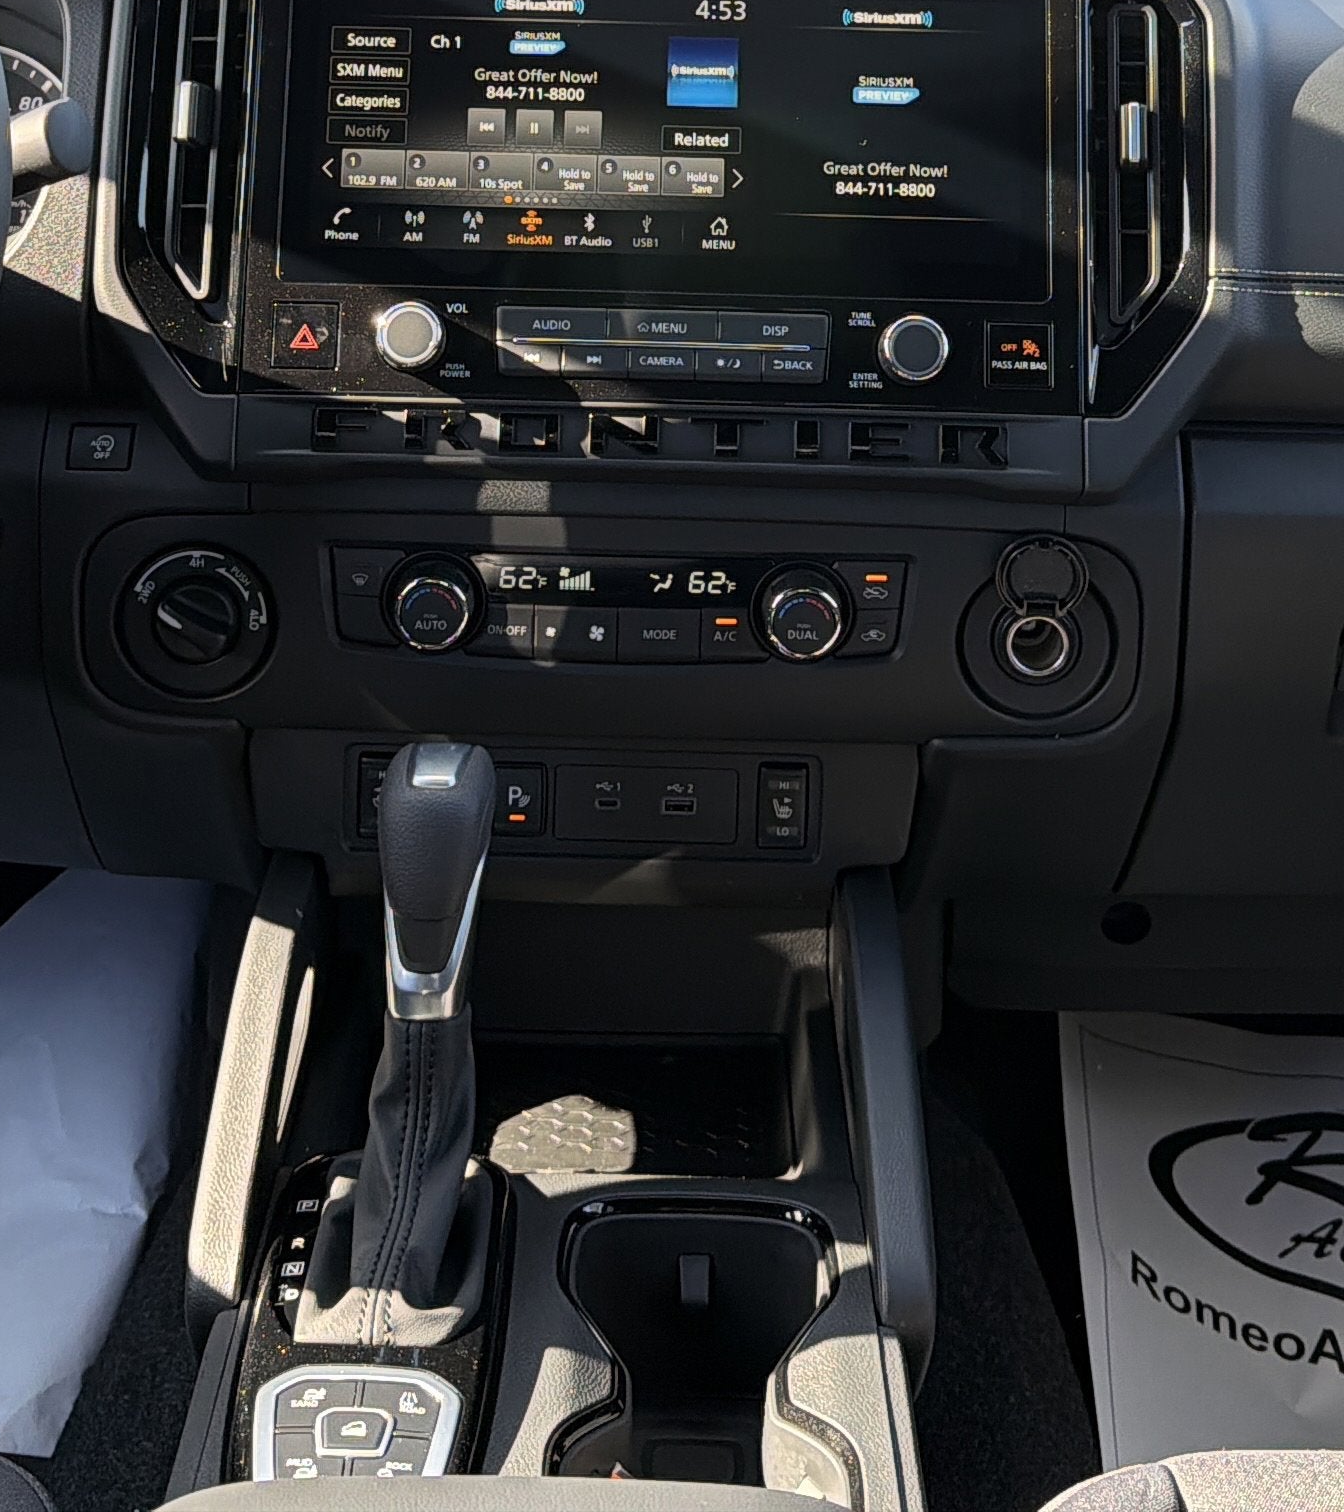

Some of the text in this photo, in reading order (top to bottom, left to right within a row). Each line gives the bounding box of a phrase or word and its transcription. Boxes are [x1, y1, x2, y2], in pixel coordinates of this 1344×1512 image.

[696, 0, 747, 21] 4:53
[347, 33, 396, 47] Source
[430, 34, 462, 49] Ch 1
[337, 64, 403, 78] SXM Menu
[474, 68, 598, 84] Great Offer Now!
[858, 75, 914, 87] SIRIUSXM
[486, 86, 585, 102] 844-711-8800
[336, 94, 401, 110] Categories
[344, 124, 391, 141] Notify
[674, 132, 729, 147] Related
[559, 169, 591, 180] Hold to
[823, 161, 948, 178] Great Offer Now!
[348, 175, 397, 186] 102.9 FM
[415, 176, 457, 188] 620 AM
[622, 170, 655, 182] Hold to
[686, 172, 719, 184] Hold to
[479, 178, 523, 192] 10s Spot
[564, 179, 586, 191] Save
[627, 181, 649, 193] Save
[691, 183, 713, 195] Save
[835, 181, 936, 197] 844-711-8800
[324, 229, 359, 241] Phone
[403, 231, 424, 242] AM
[463, 232, 480, 243] FM
[506, 234, 553, 246] SiriusXM
[565, 235, 613, 247] BT Audio
[632, 237, 659, 248] USB1
[702, 238, 736, 250] MENU
[446, 303, 468, 314] VOL
[851, 312, 872, 320] TUNE
[532, 319, 571, 331] AUDIO
[652, 321, 688, 334] MENU
[848, 318, 876, 327] SCROLL
[762, 325, 789, 336] DISP
[1001, 343, 1018, 353] OFF
[445, 362, 466, 371] PUSH
[639, 355, 684, 367] CAMERA
[784, 359, 814, 371] BACK
[991, 360, 1048, 371] PASS AIR BAG
[439, 369, 471, 379] POWER
[852, 372, 878, 381] ENTER
[848, 380, 883, 389] SETTING
[313, 407, 1008, 469] FRONTIER
[189, 557, 205, 568] 4H
[230, 566, 251, 588] PUSH
[137, 580, 156, 605] 2WD
[248, 608, 260, 631] 4LO
[414, 620, 448, 631] AUTO
[642, 629, 677, 640] MODE
[713, 630, 737, 642] A/C
[787, 630, 819, 641] DUAL
